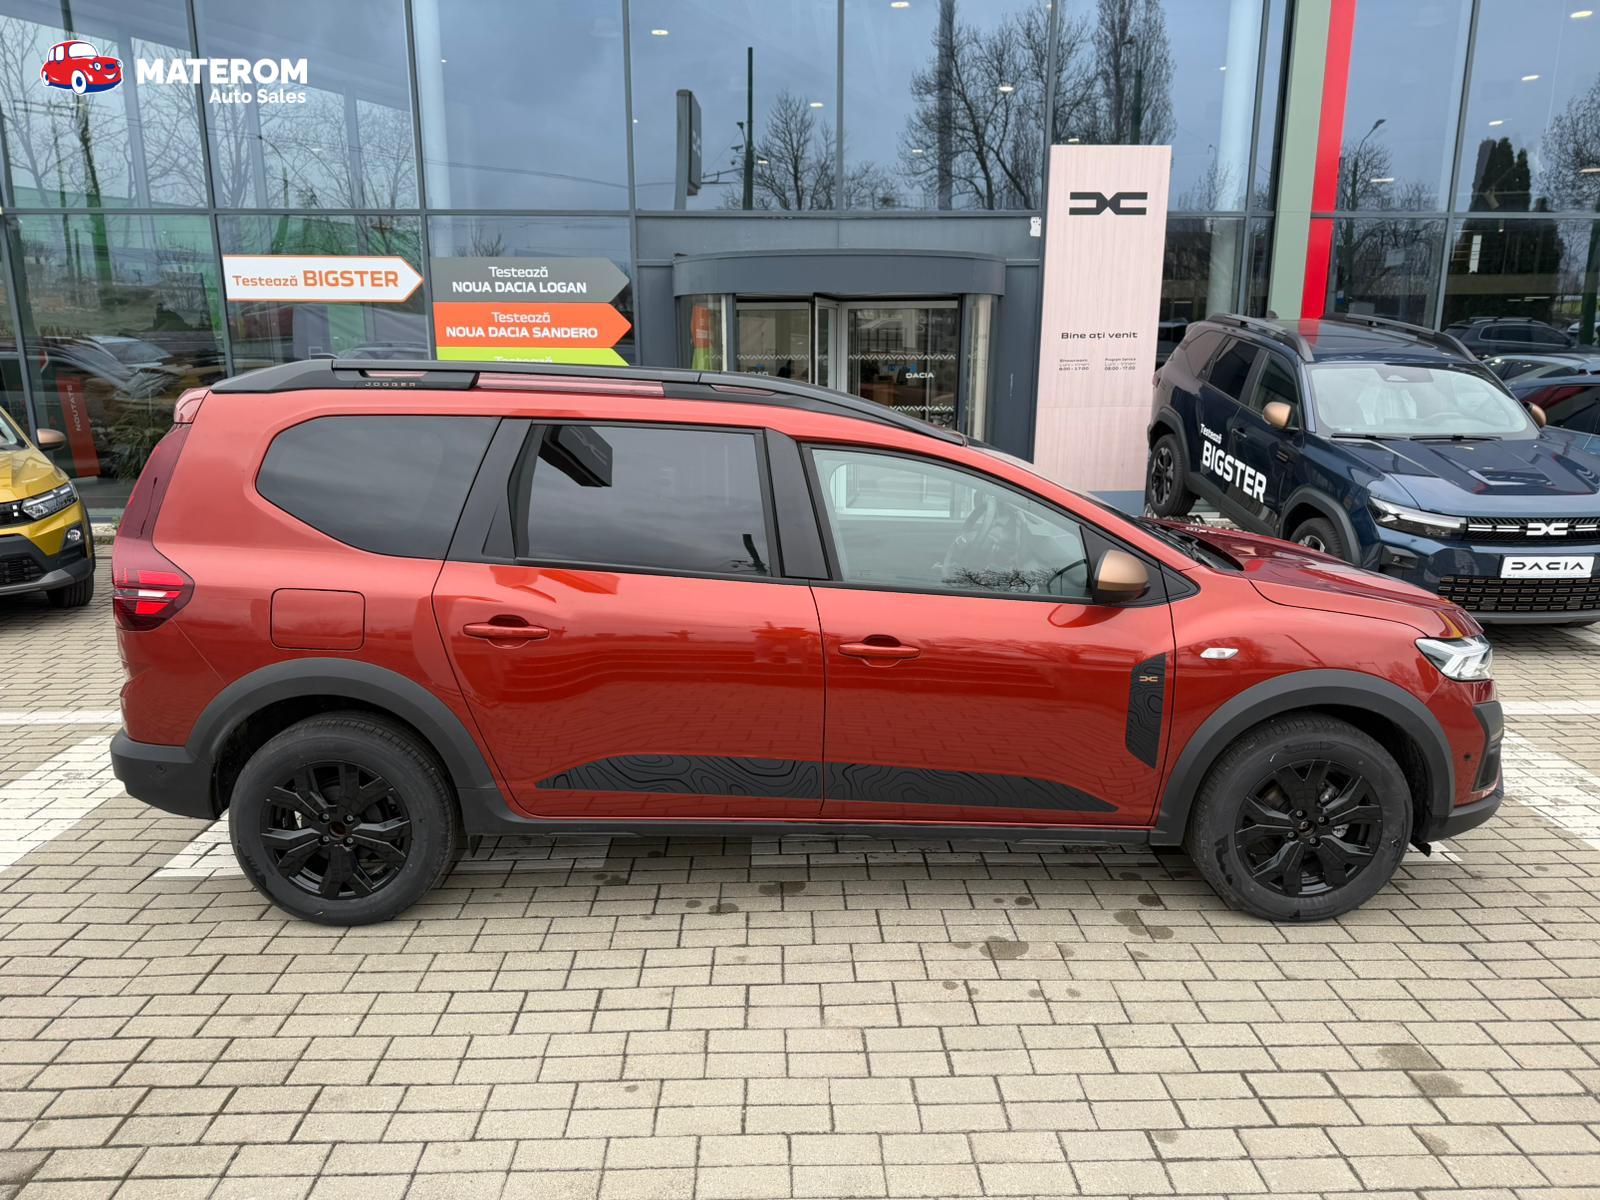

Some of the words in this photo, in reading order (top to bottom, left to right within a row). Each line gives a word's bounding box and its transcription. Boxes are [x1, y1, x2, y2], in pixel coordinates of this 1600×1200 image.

[488, 266, 548, 278] Testează
[232, 275, 298, 287] Testează
[303, 270, 399, 287] BIGSTER
[452, 281, 492, 293] NOUA
[495, 282, 536, 293] DACIA
[539, 282, 587, 293] LOGAN
[491, 312, 551, 323] Testează
[446, 326, 485, 338] NOUA
[488, 327, 530, 338] DACIA
[532, 327, 599, 339] SANDERO
[1202, 440, 1267, 504] BIGSTER
[1511, 562, 1585, 571] DACIA
